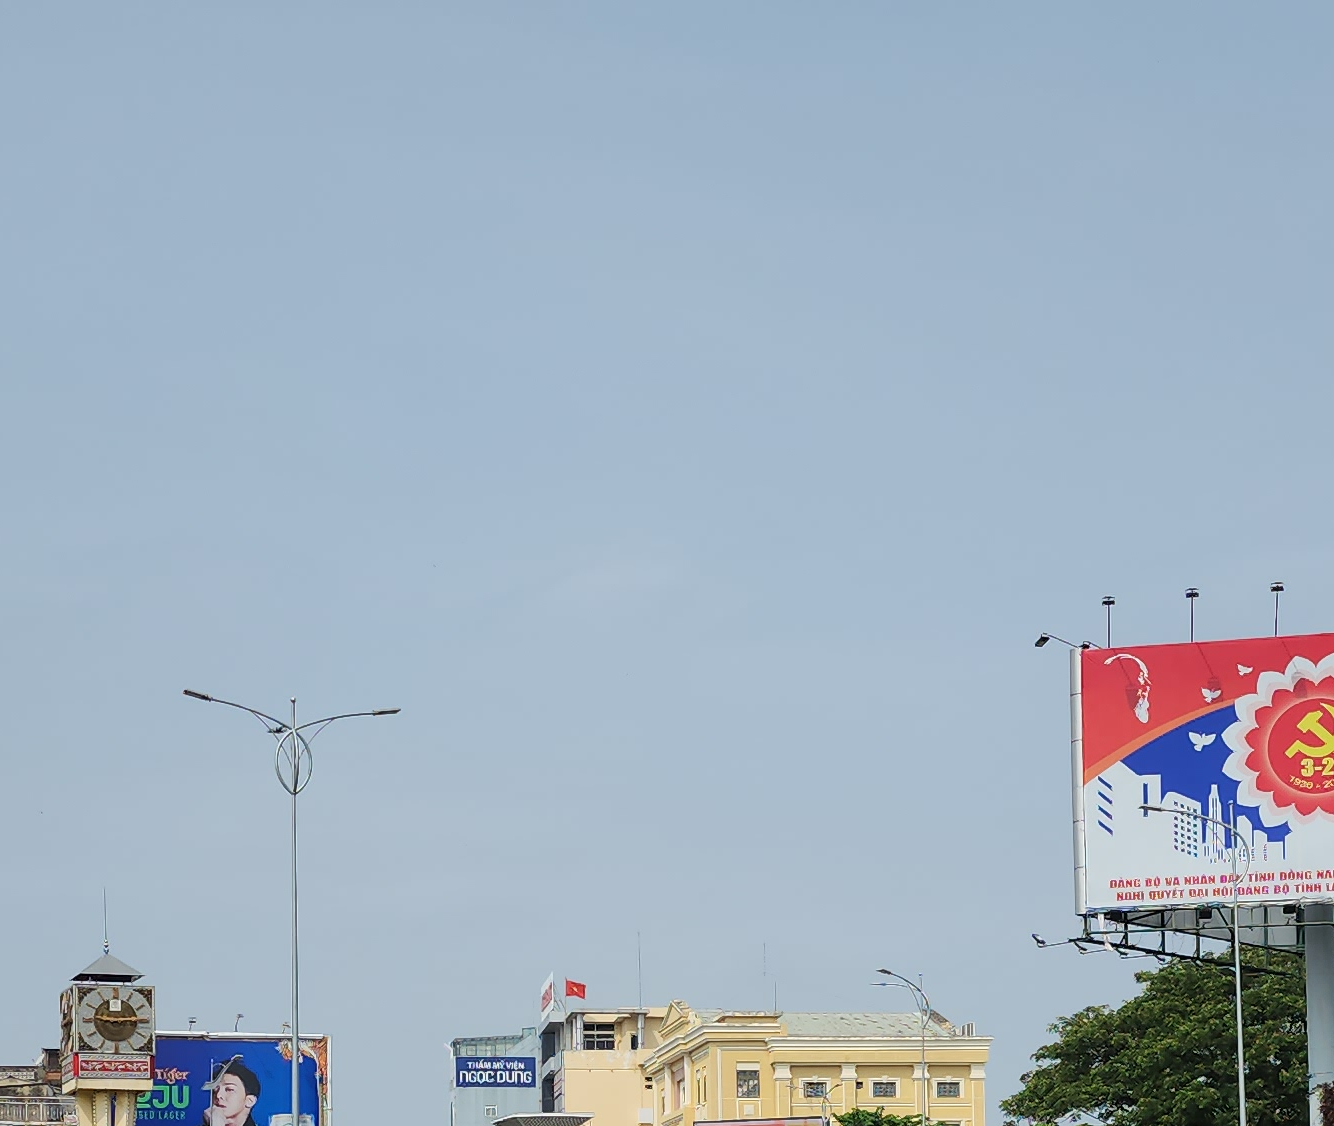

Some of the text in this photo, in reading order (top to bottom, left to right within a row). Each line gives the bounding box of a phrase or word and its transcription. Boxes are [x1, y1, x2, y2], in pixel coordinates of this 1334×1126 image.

[1300, 757, 1334, 777] 3-2
[1289, 775, 1313, 789] 1930
[155, 1067, 190, 1084] Tiger
[459, 1071, 532, 1084] NGỌC DUNG
[158, 1110, 186, 1120] LAGER
